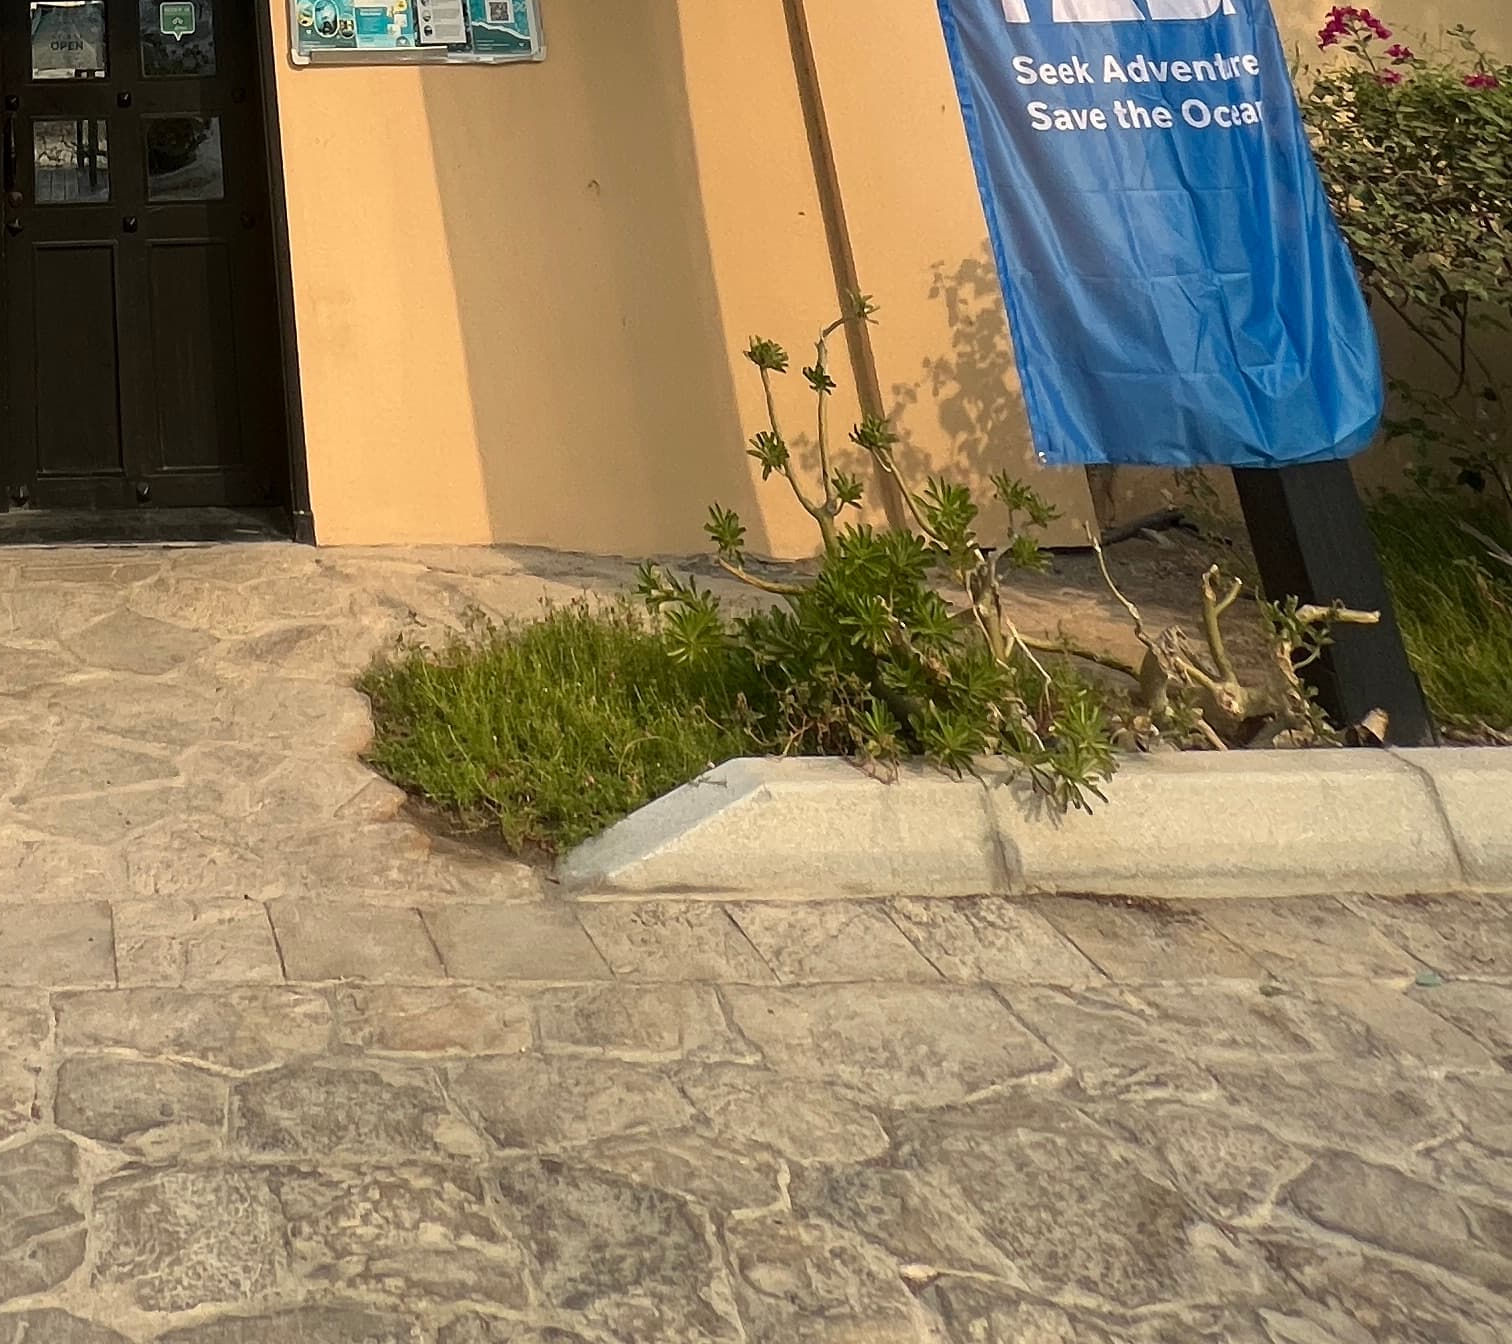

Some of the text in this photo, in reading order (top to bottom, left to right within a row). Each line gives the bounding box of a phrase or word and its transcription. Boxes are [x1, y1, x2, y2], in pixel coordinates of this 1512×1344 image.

[50, 40, 84, 51] OPEN
[1011, 55, 1095, 86] Seek
[1026, 99, 1107, 131] Save
[1113, 99, 1173, 130] the
